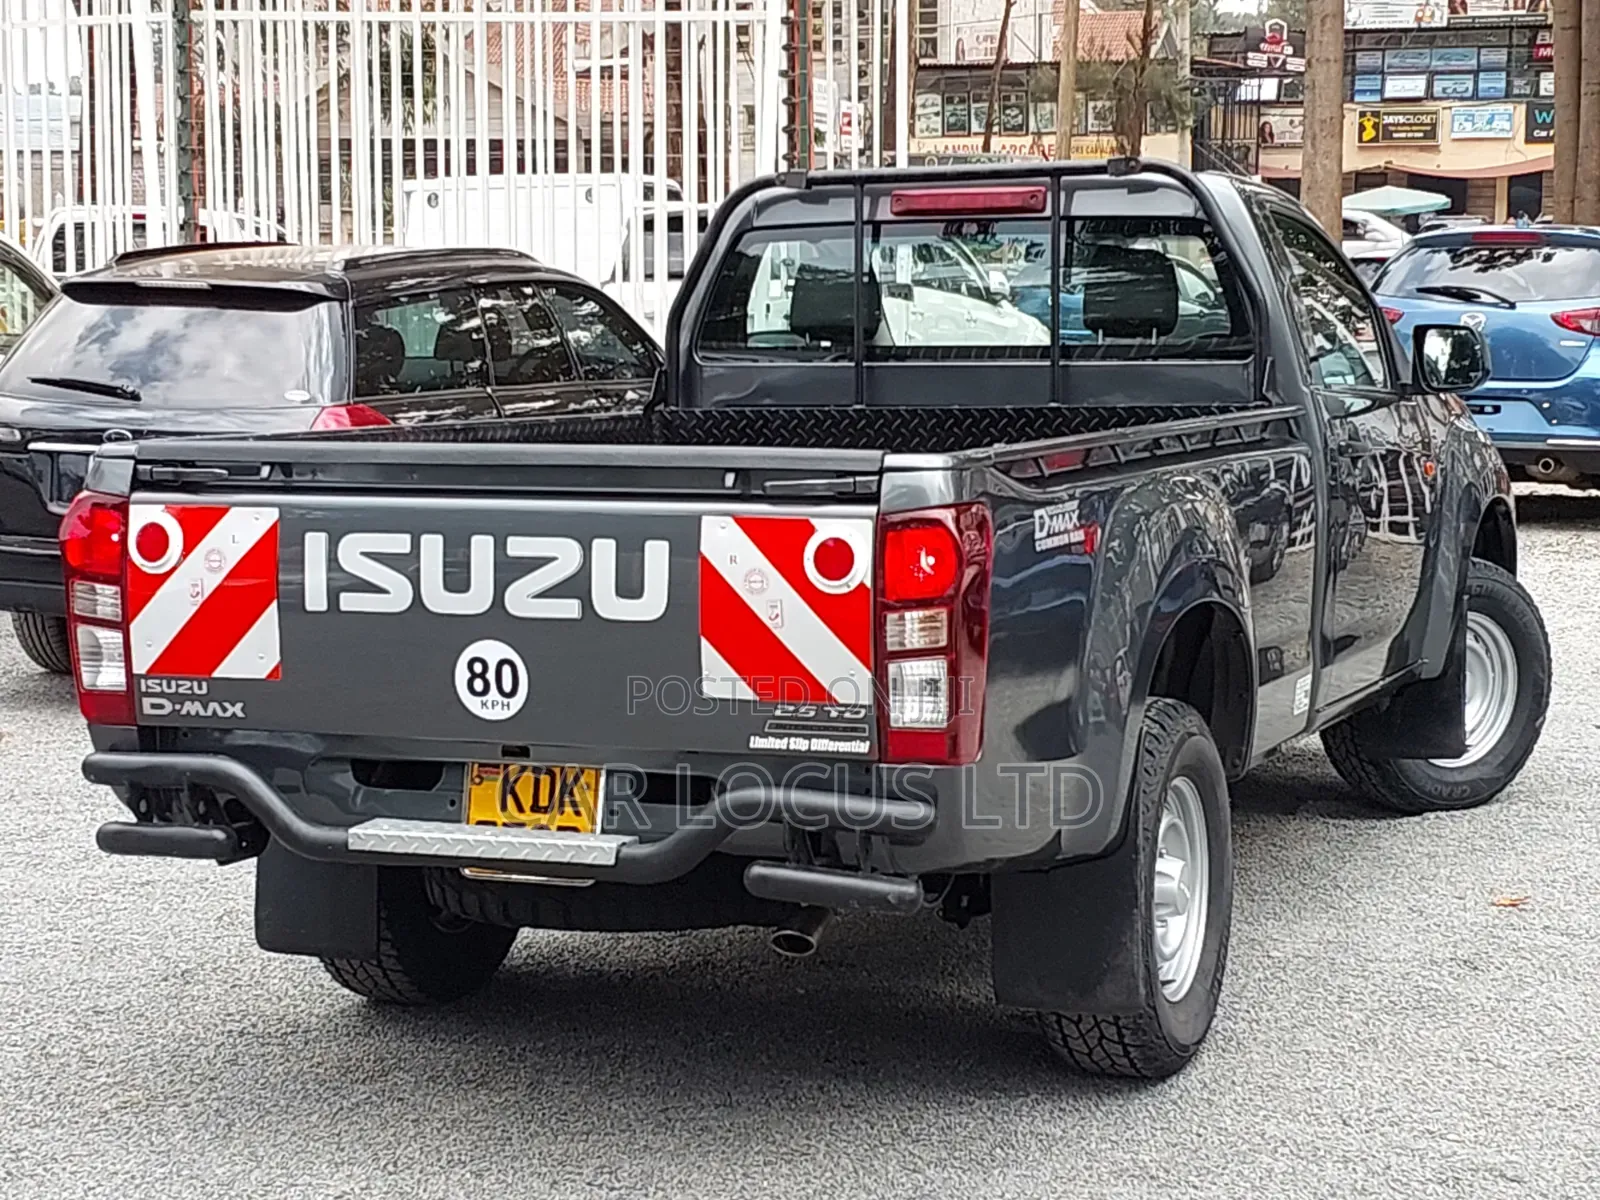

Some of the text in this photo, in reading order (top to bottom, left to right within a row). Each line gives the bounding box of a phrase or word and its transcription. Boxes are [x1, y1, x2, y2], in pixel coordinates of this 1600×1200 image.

[232, 534, 240, 544] L
[729, 554, 738, 565] R
[304, 531, 670, 622] ISUZU
[466, 656, 519, 699] 80
[140, 678, 208, 695] ISUZU
[480, 700, 511, 712] KPH
[749, 736, 871, 753] Limited Slip Differential
[501, 763, 584, 817] KDK
